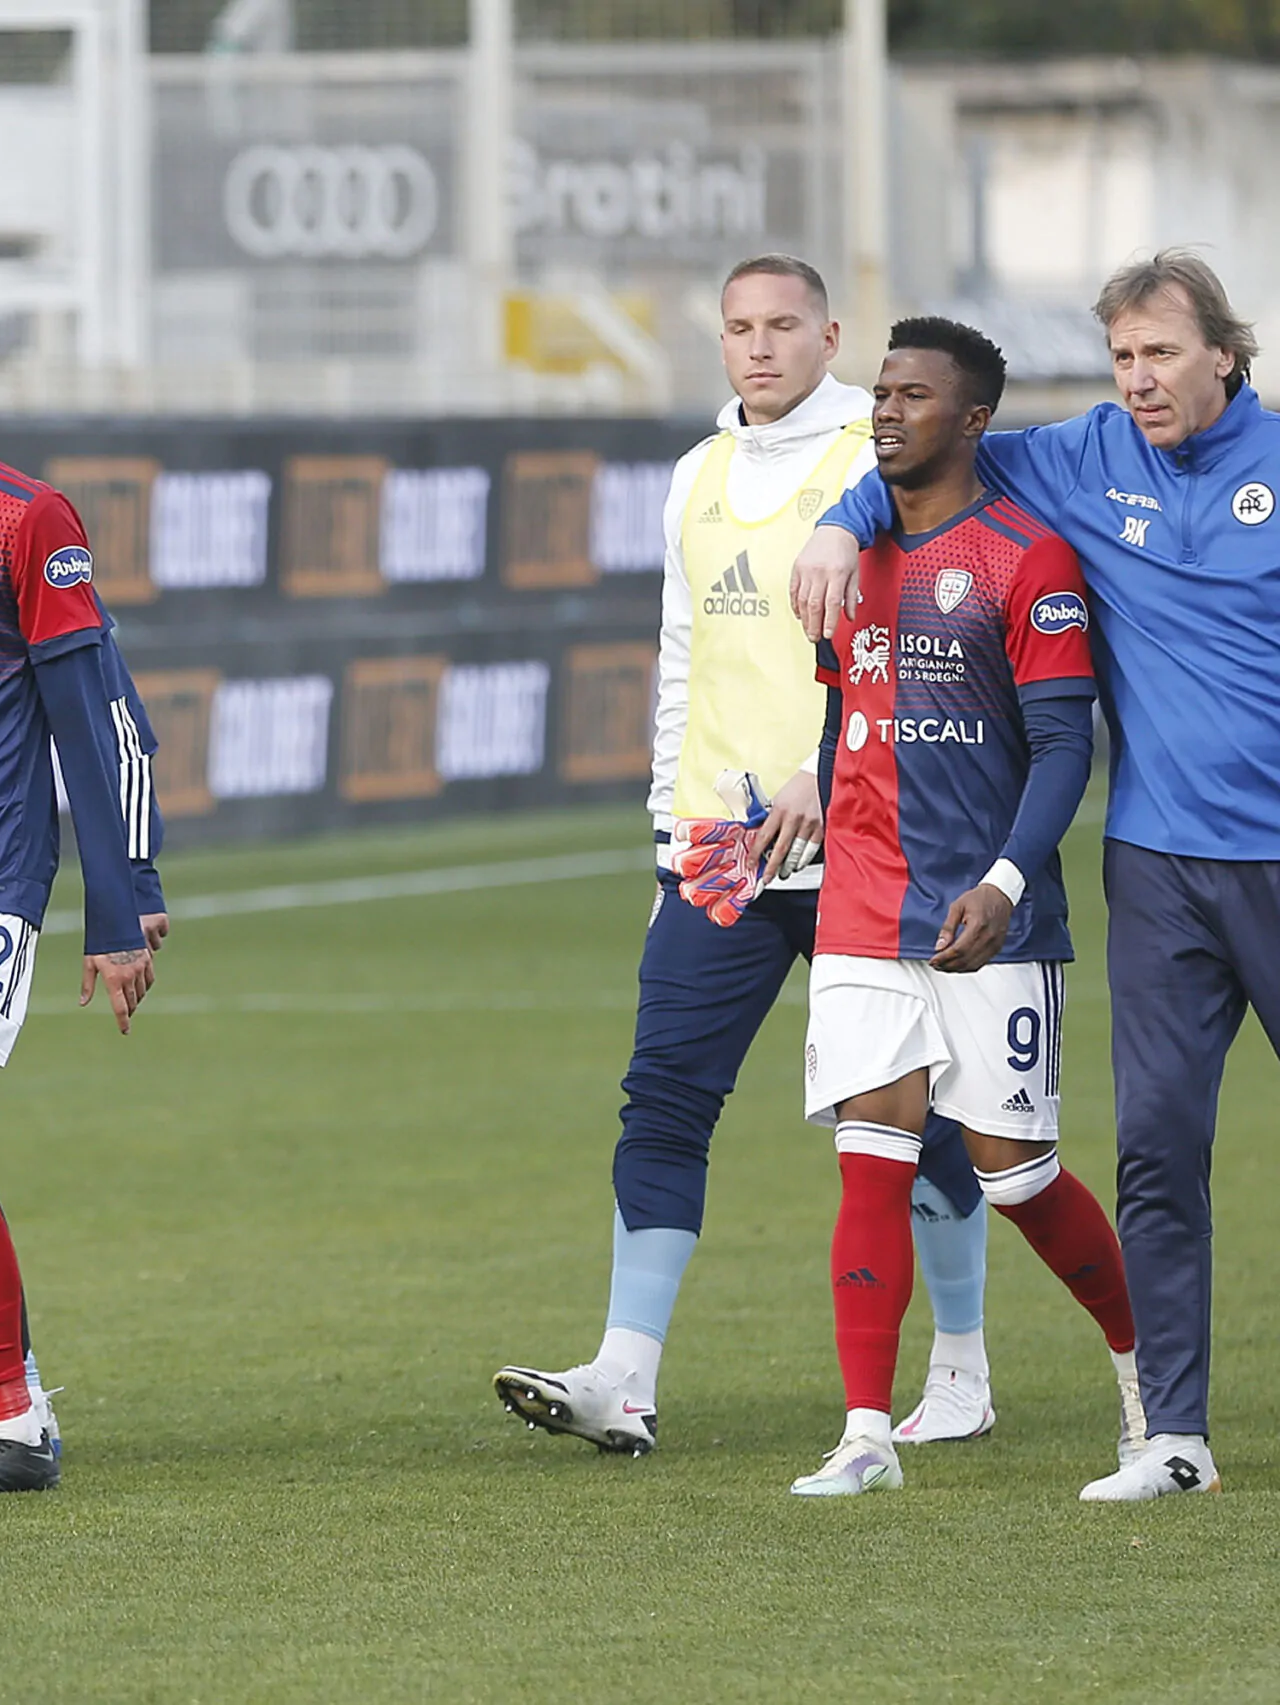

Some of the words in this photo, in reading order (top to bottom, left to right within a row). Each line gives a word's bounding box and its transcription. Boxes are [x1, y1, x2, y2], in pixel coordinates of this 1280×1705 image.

[1119, 515, 1151, 548] RK
[703, 592, 771, 618] adidas
[900, 633, 964, 659] ISOLA
[899, 669, 912, 680] DI
[914, 669, 965, 683] SRDEGN
[876, 718, 984, 745] TISCALI
[1007, 1006, 1041, 1072] 9
[1001, 1100, 1035, 1114] adidas
